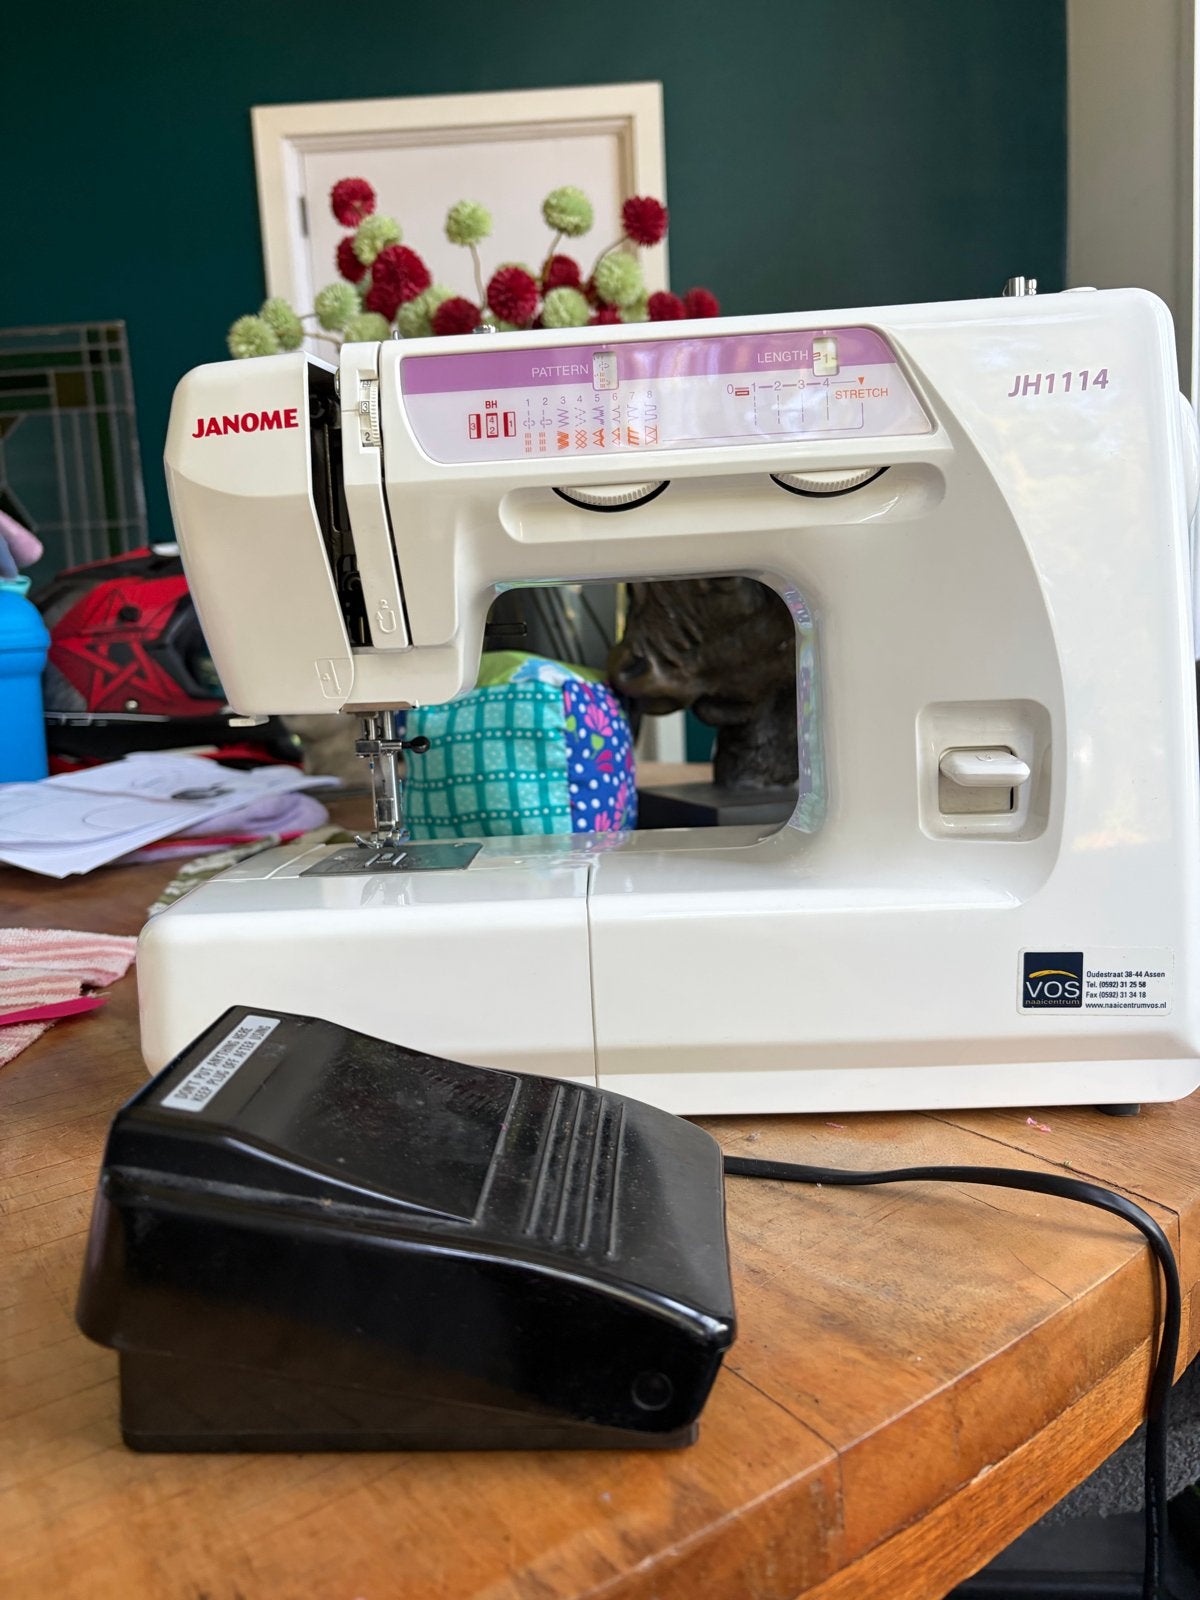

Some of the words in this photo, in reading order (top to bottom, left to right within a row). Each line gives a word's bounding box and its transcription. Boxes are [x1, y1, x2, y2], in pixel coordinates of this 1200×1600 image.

[757, 350, 809, 364] LENGTH
[532, 364, 589, 379] PATTERN
[774, 381, 781, 391] 2
[798, 379, 806, 389] 3
[822, 378, 830, 388] 4
[1007, 368, 1109, 398] JH1114
[542, 397, 548, 406] 2
[560, 396, 566, 405] 3
[577, 395, 583, 403] 4
[594, 394, 600, 403] 5
[612, 392, 618, 401] 6
[629, 391, 635, 400] 7
[647, 390, 653, 399] 8
[834, 387, 889, 400] STRETCH
[362, 402, 368, 412] 3
[485, 400, 498, 409] BH
[191, 408, 299, 439] JANOME
[489, 416, 495, 424] 4
[364, 431, 371, 441] 2
[489, 427, 495, 435] 2
[1025, 981, 1080, 998] VOS
[1098, 991, 1119, 999] (0592)
[193, 1067, 213, 1080] PUT
[206, 1040, 240, 1067] ANYTHING
[231, 1027, 253, 1040] HERE
[191, 1086, 214, 1102] KEEP
[206, 1070, 230, 1086] PLUG
[222, 1058, 240, 1070] OFF
[233, 1041, 257, 1058] AFTER
